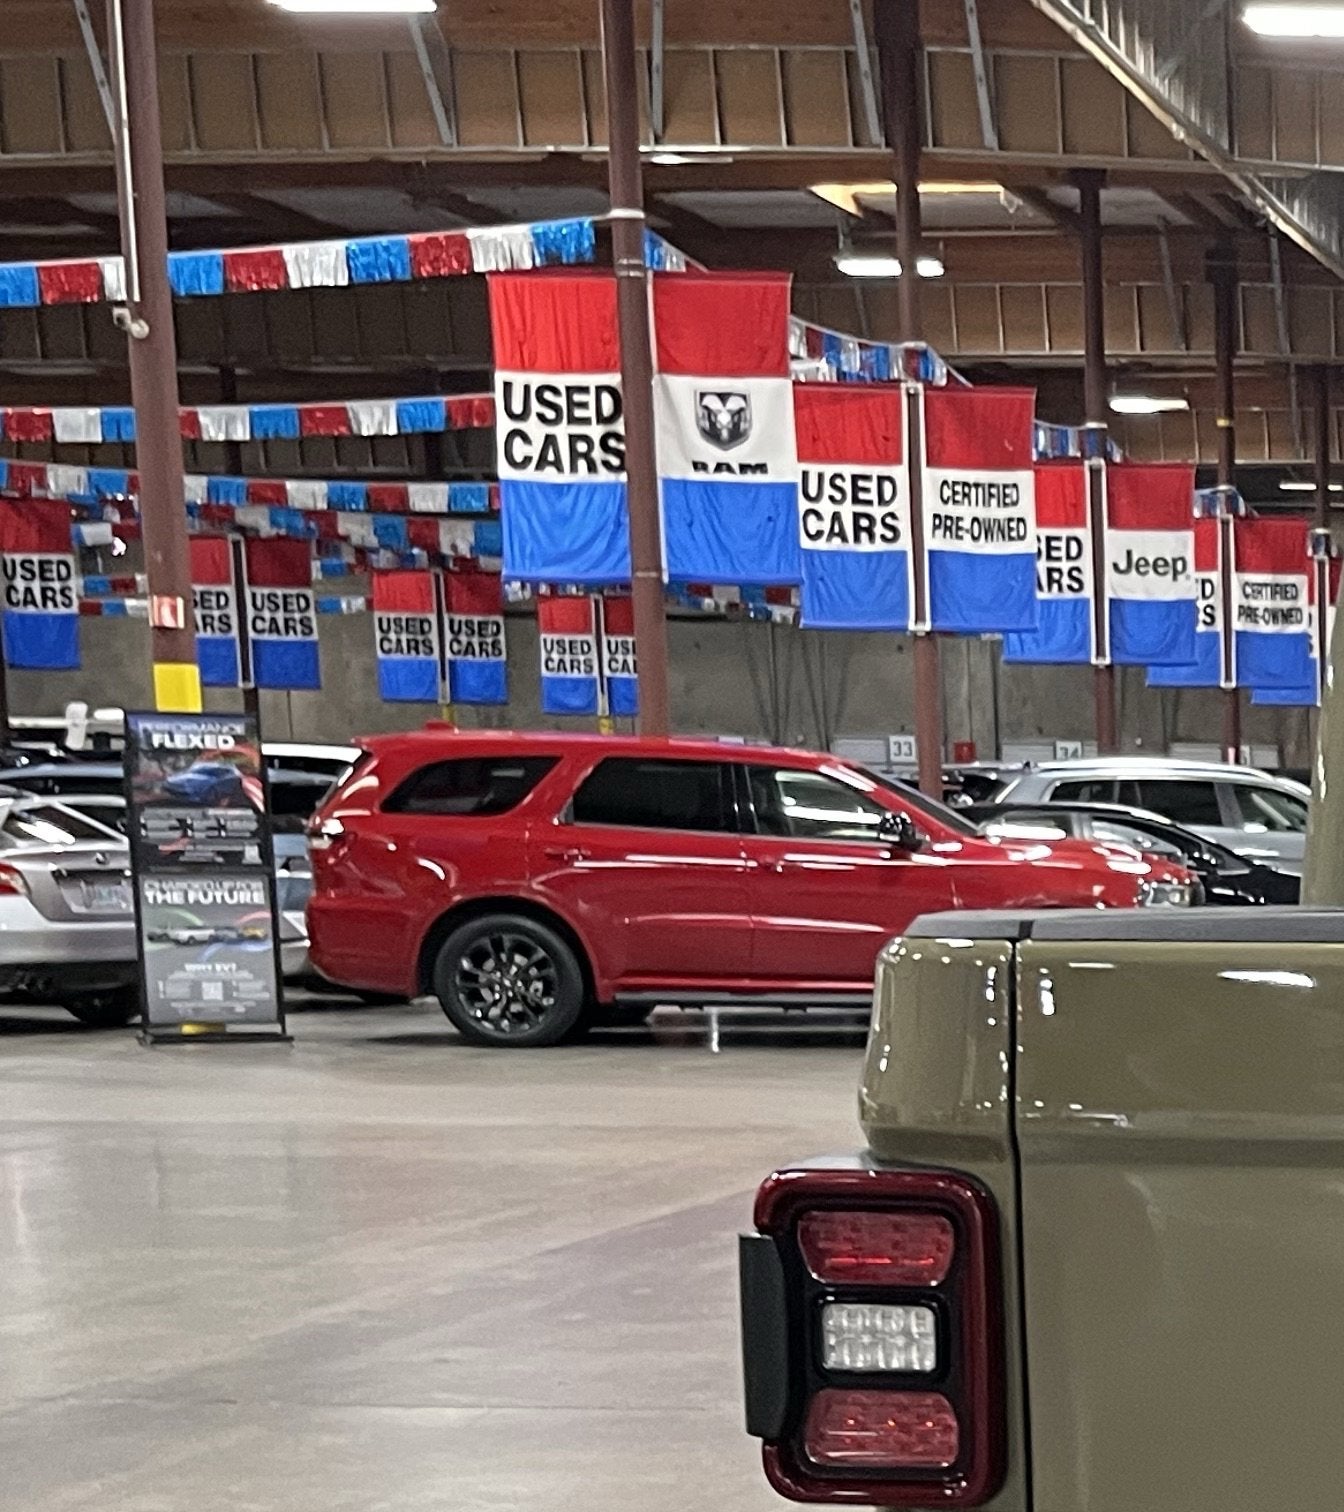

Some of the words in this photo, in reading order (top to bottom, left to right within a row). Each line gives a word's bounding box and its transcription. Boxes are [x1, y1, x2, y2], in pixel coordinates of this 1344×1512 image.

[502, 380, 623, 427] USED
[503, 428, 626, 474] CARS
[691, 458, 769, 476] RAM
[801, 470, 898, 506] USED
[939, 479, 1020, 508] CERTIFIED
[801, 508, 901, 545] CARS
[931, 512, 1028, 543] PRE-OWNED
[1036, 535, 1084, 562] ED
[2, 558, 71, 582] USED
[1112, 549, 1188, 582] Jeep
[1036, 566, 1085, 594] RS
[5, 584, 74, 610] CARS
[193, 589, 230, 611] ED
[250, 591, 311, 614] USED
[1242, 582, 1299, 601] CERTIFIED
[194, 613, 233, 634] RS
[1236, 604, 1304, 625] PRE-OWNED
[251, 615, 314, 637] CARS
[377, 616, 433, 636] USED
[448, 618, 502, 638] USED
[379, 636, 434, 656] CARS
[448, 638, 503, 658] CARS
[543, 637, 592, 656] USED
[606, 639, 637, 656] US
[544, 656, 594, 674] CARS
[607, 658, 638, 674] CA
[892, 740, 913, 757] 33
